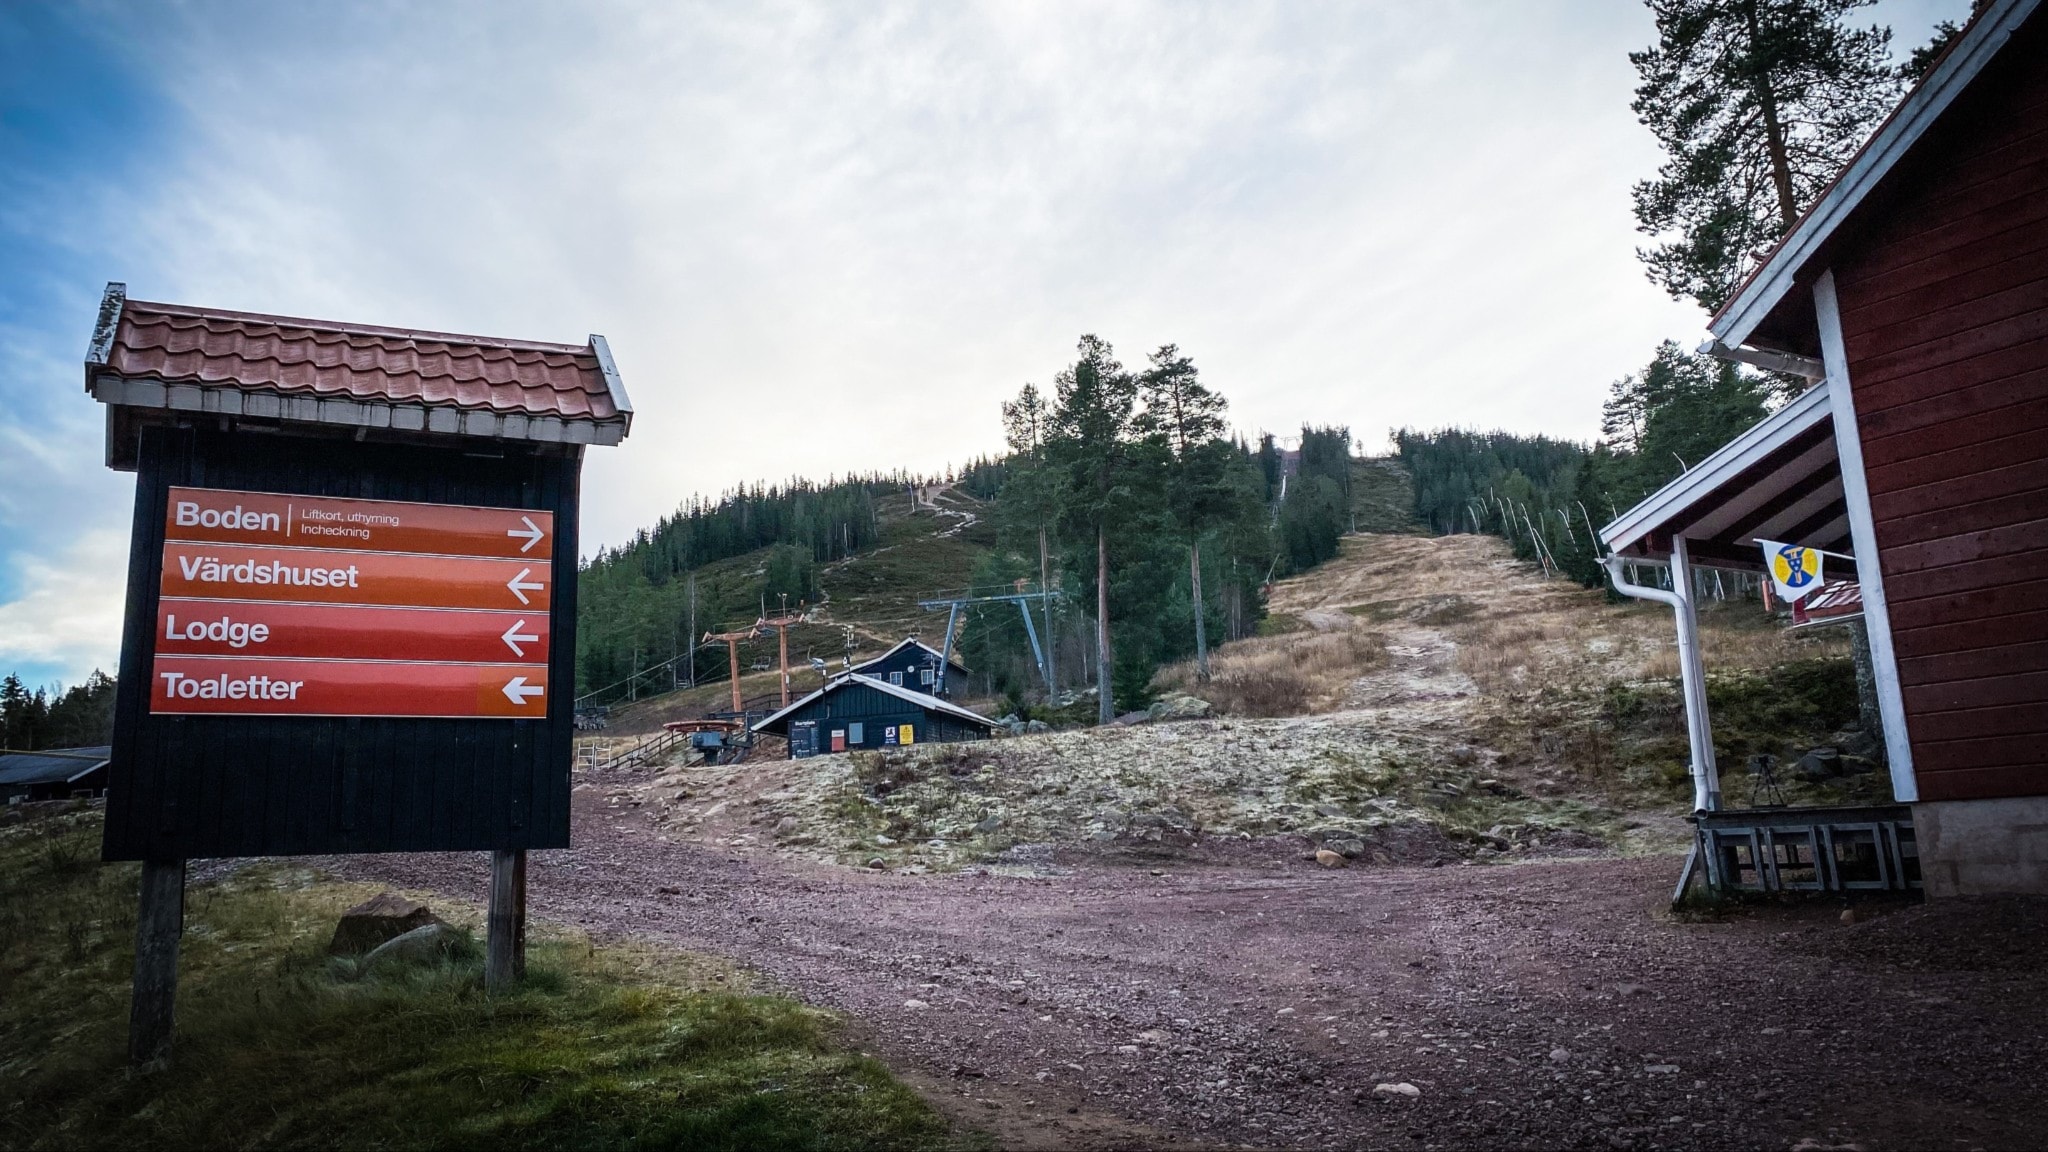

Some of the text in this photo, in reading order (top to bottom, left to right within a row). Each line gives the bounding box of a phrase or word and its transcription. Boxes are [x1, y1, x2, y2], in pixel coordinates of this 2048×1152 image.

[175, 501, 280, 532] Boden
[301, 523, 370, 540] Incheckning
[302, 508, 400, 527] Liftkort, uthyrning
[178, 555, 359, 589] Värdshuset
[165, 614, 270, 648] Lodge
[160, 672, 304, 701] Toaletter
